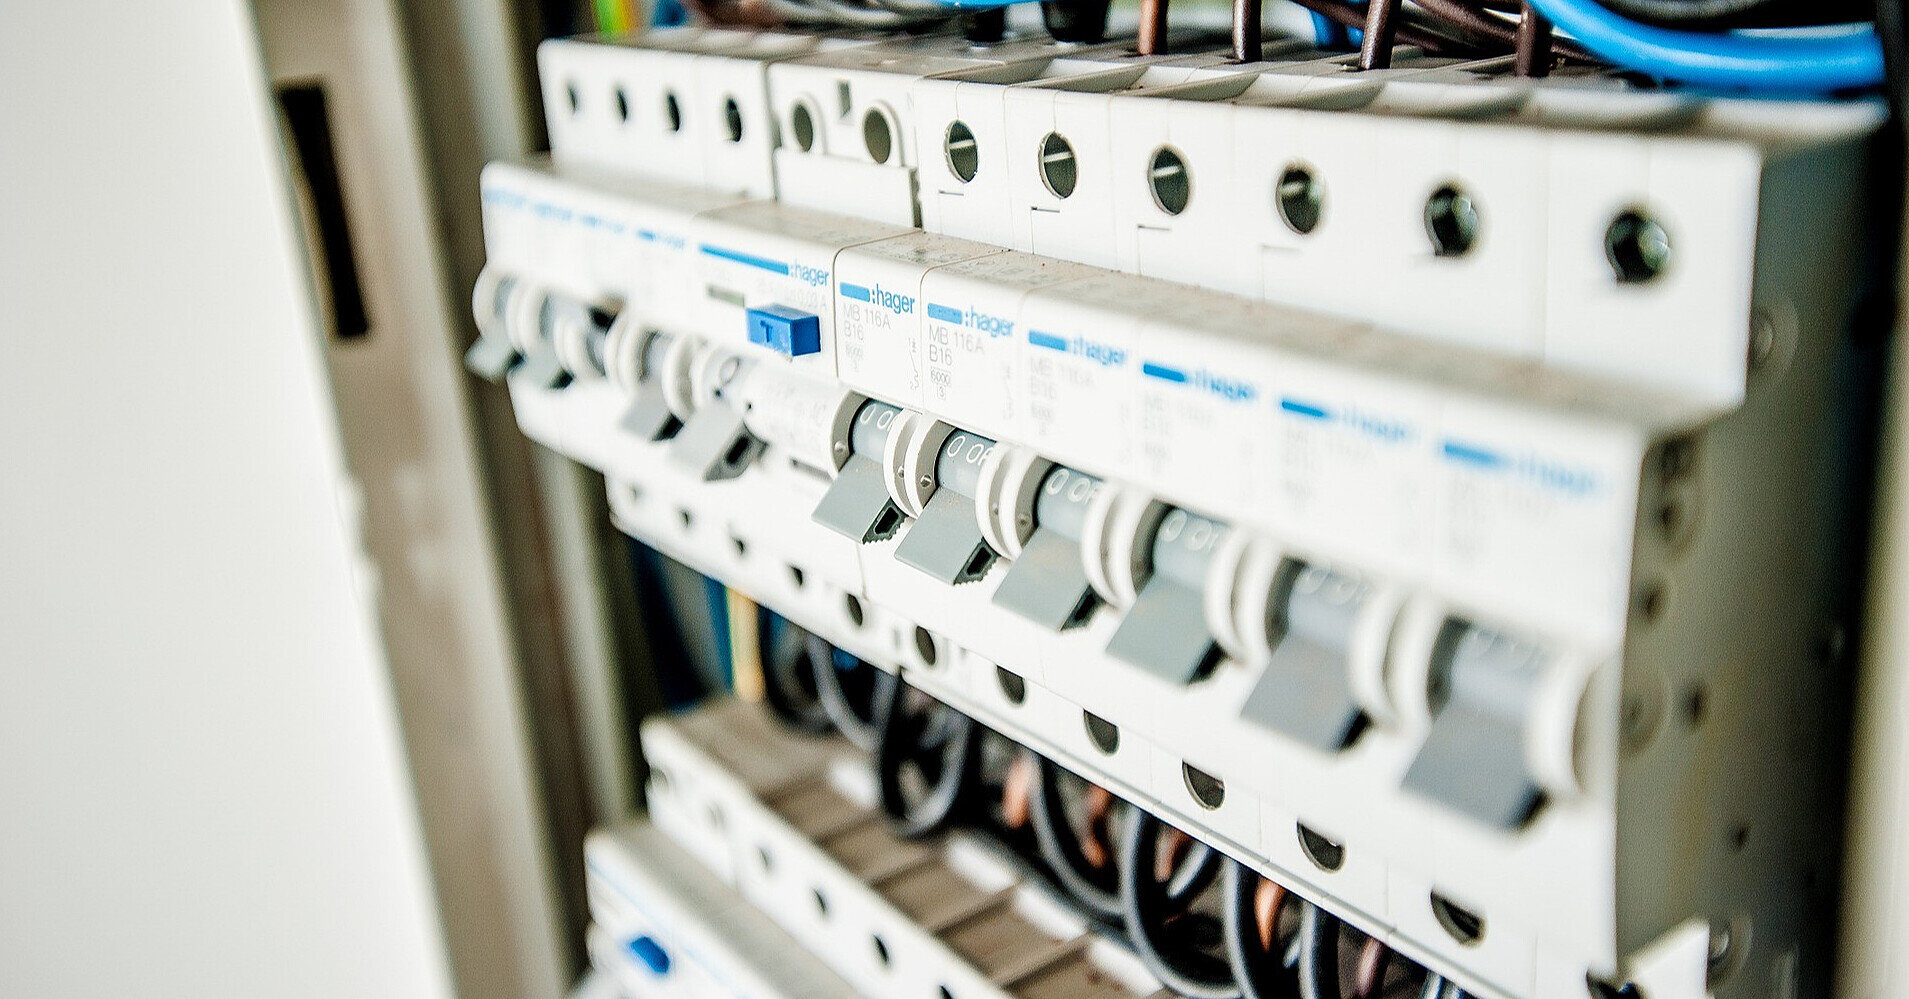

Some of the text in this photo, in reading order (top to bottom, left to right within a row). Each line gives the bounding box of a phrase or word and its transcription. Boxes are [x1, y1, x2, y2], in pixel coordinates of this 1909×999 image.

[843, 303, 891, 330] MB 116A
[843, 320, 864, 341] B16
[929, 324, 985, 355] MB 116A
[929, 344, 953, 367] B16
[930, 368, 951, 386] 6000
